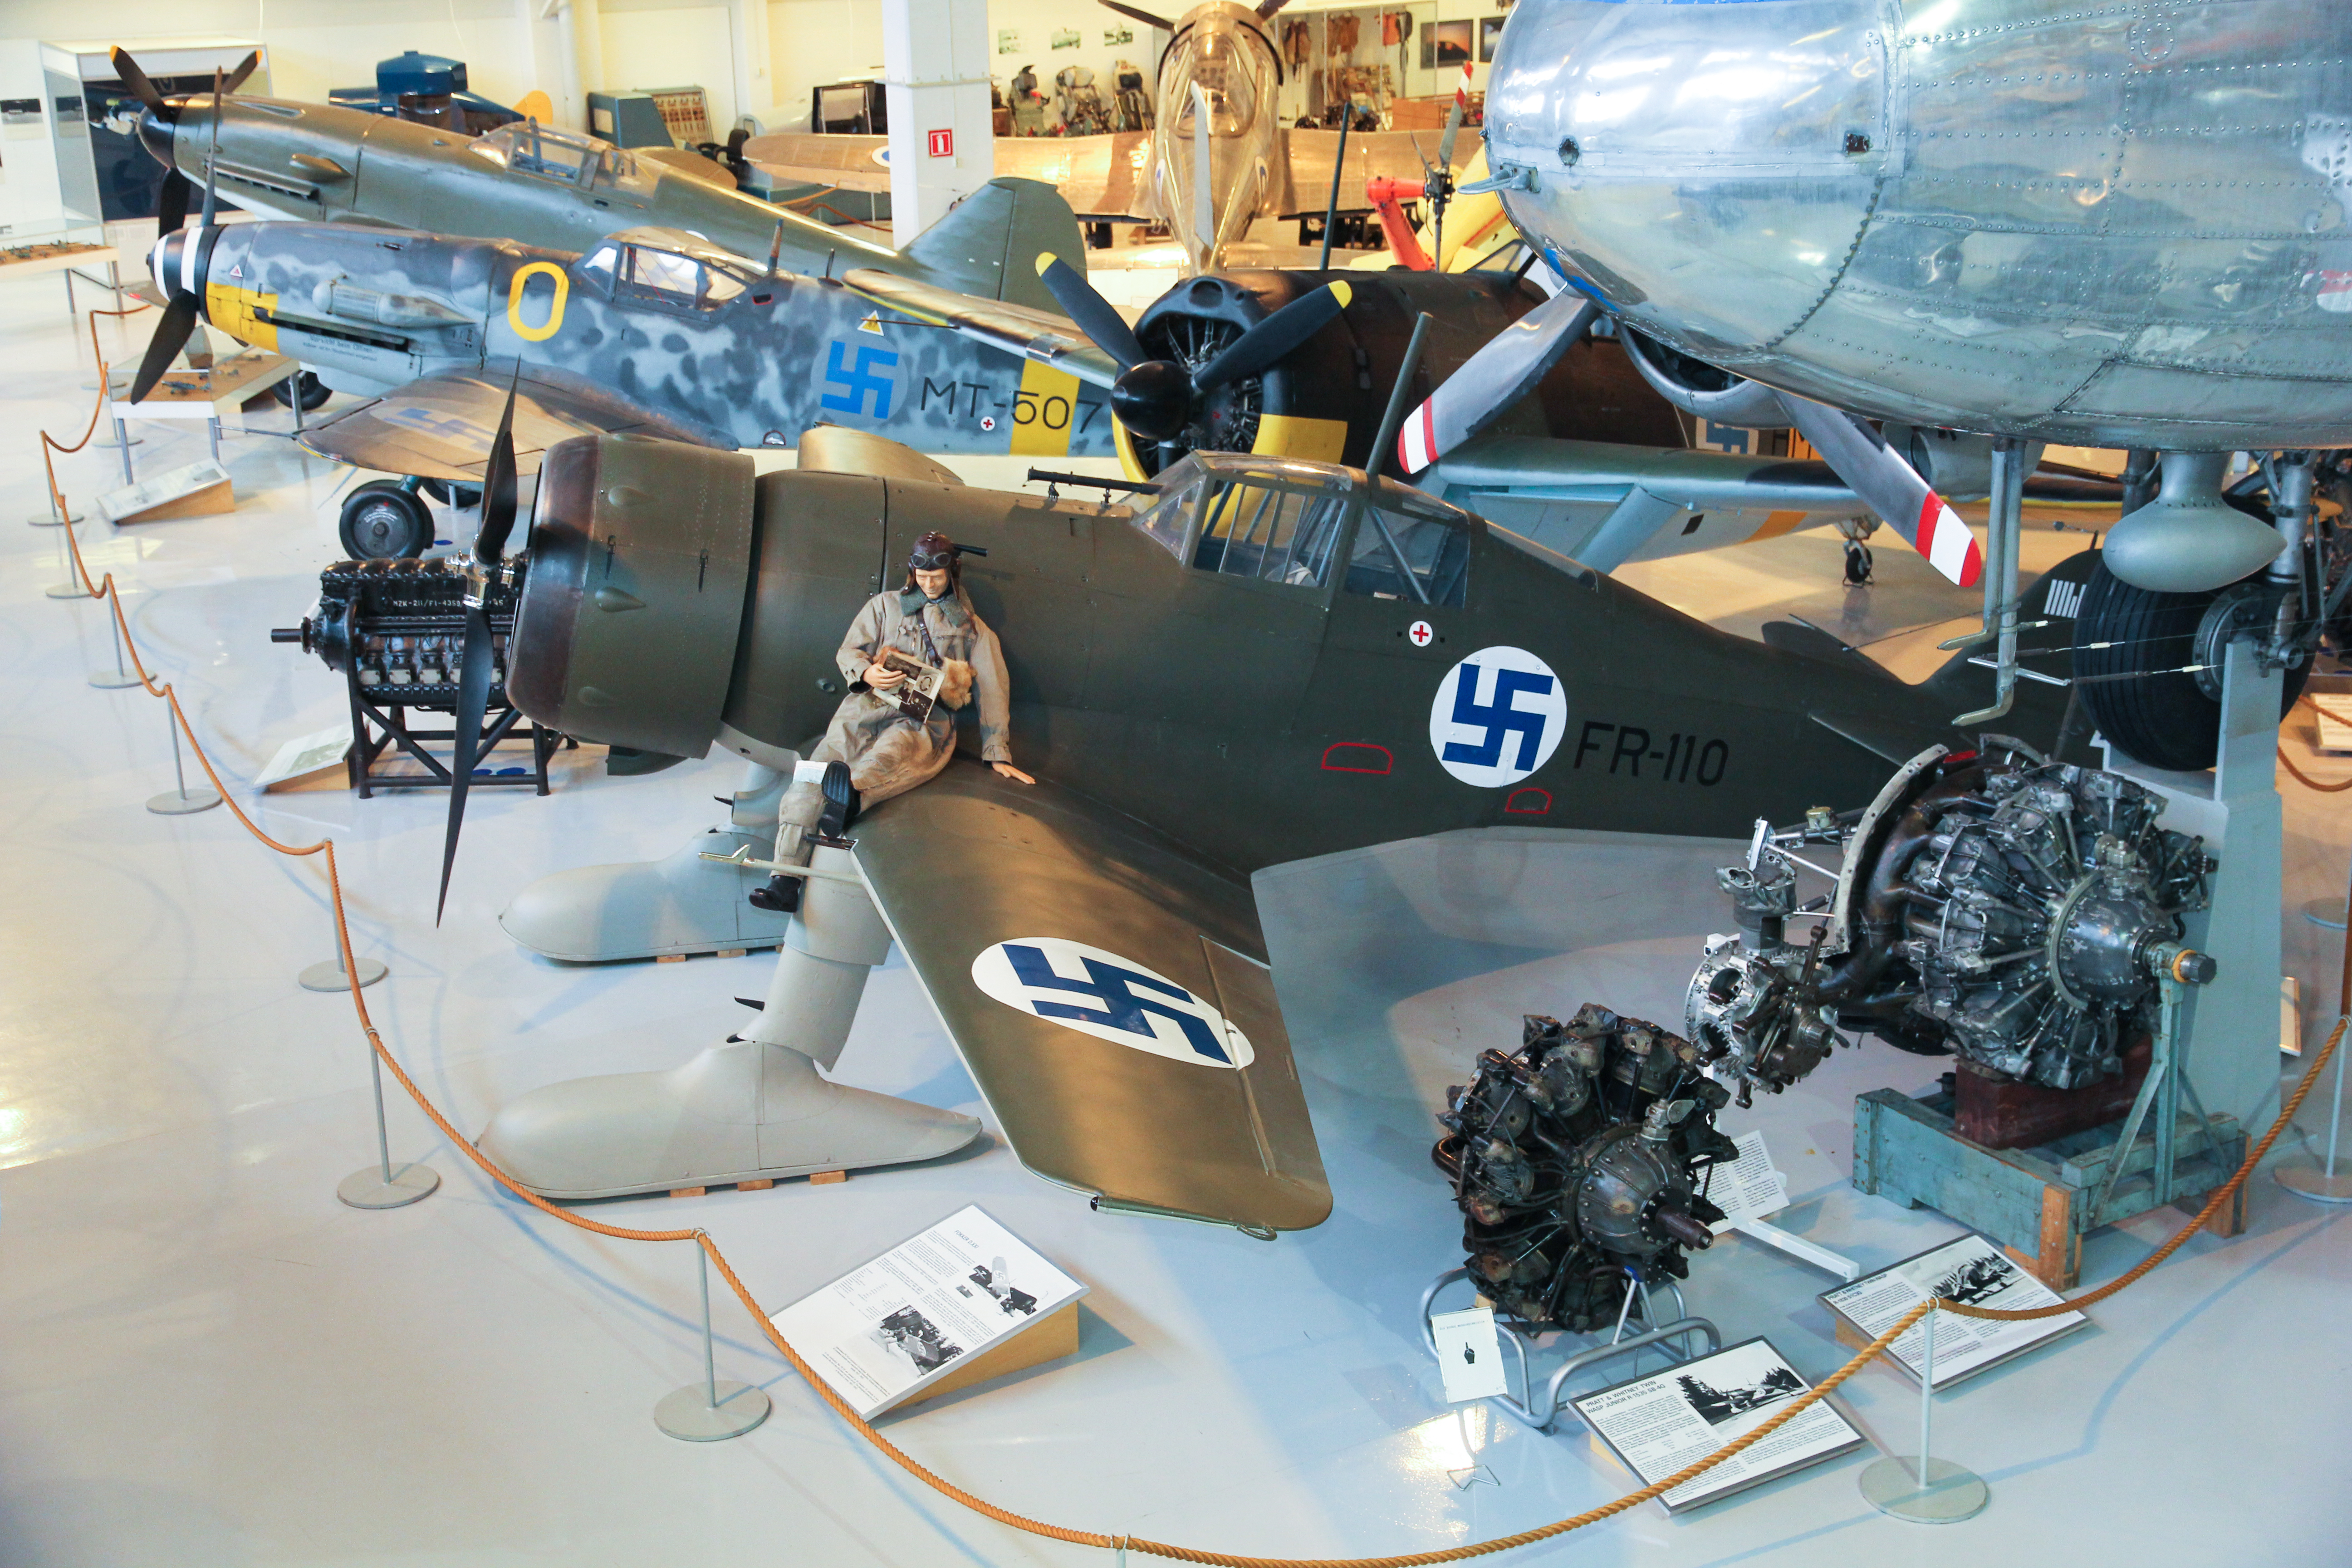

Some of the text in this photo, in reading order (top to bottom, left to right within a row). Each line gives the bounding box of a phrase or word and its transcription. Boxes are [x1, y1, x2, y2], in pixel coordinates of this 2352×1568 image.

[921, 377, 1102, 434] MT-507
[1574, 721, 1729, 786] FR-110
[954, 1230, 970, 1241] FOKKER
[1586, 1398, 1605, 1407] PRATT
[1612, 1386, 1639, 1397] WHITNEY
[1640, 1380, 1657, 1388] TWIN
[1587, 1406, 1603, 1414] WASP
[1606, 1398, 1627, 1408] JUNIOR
